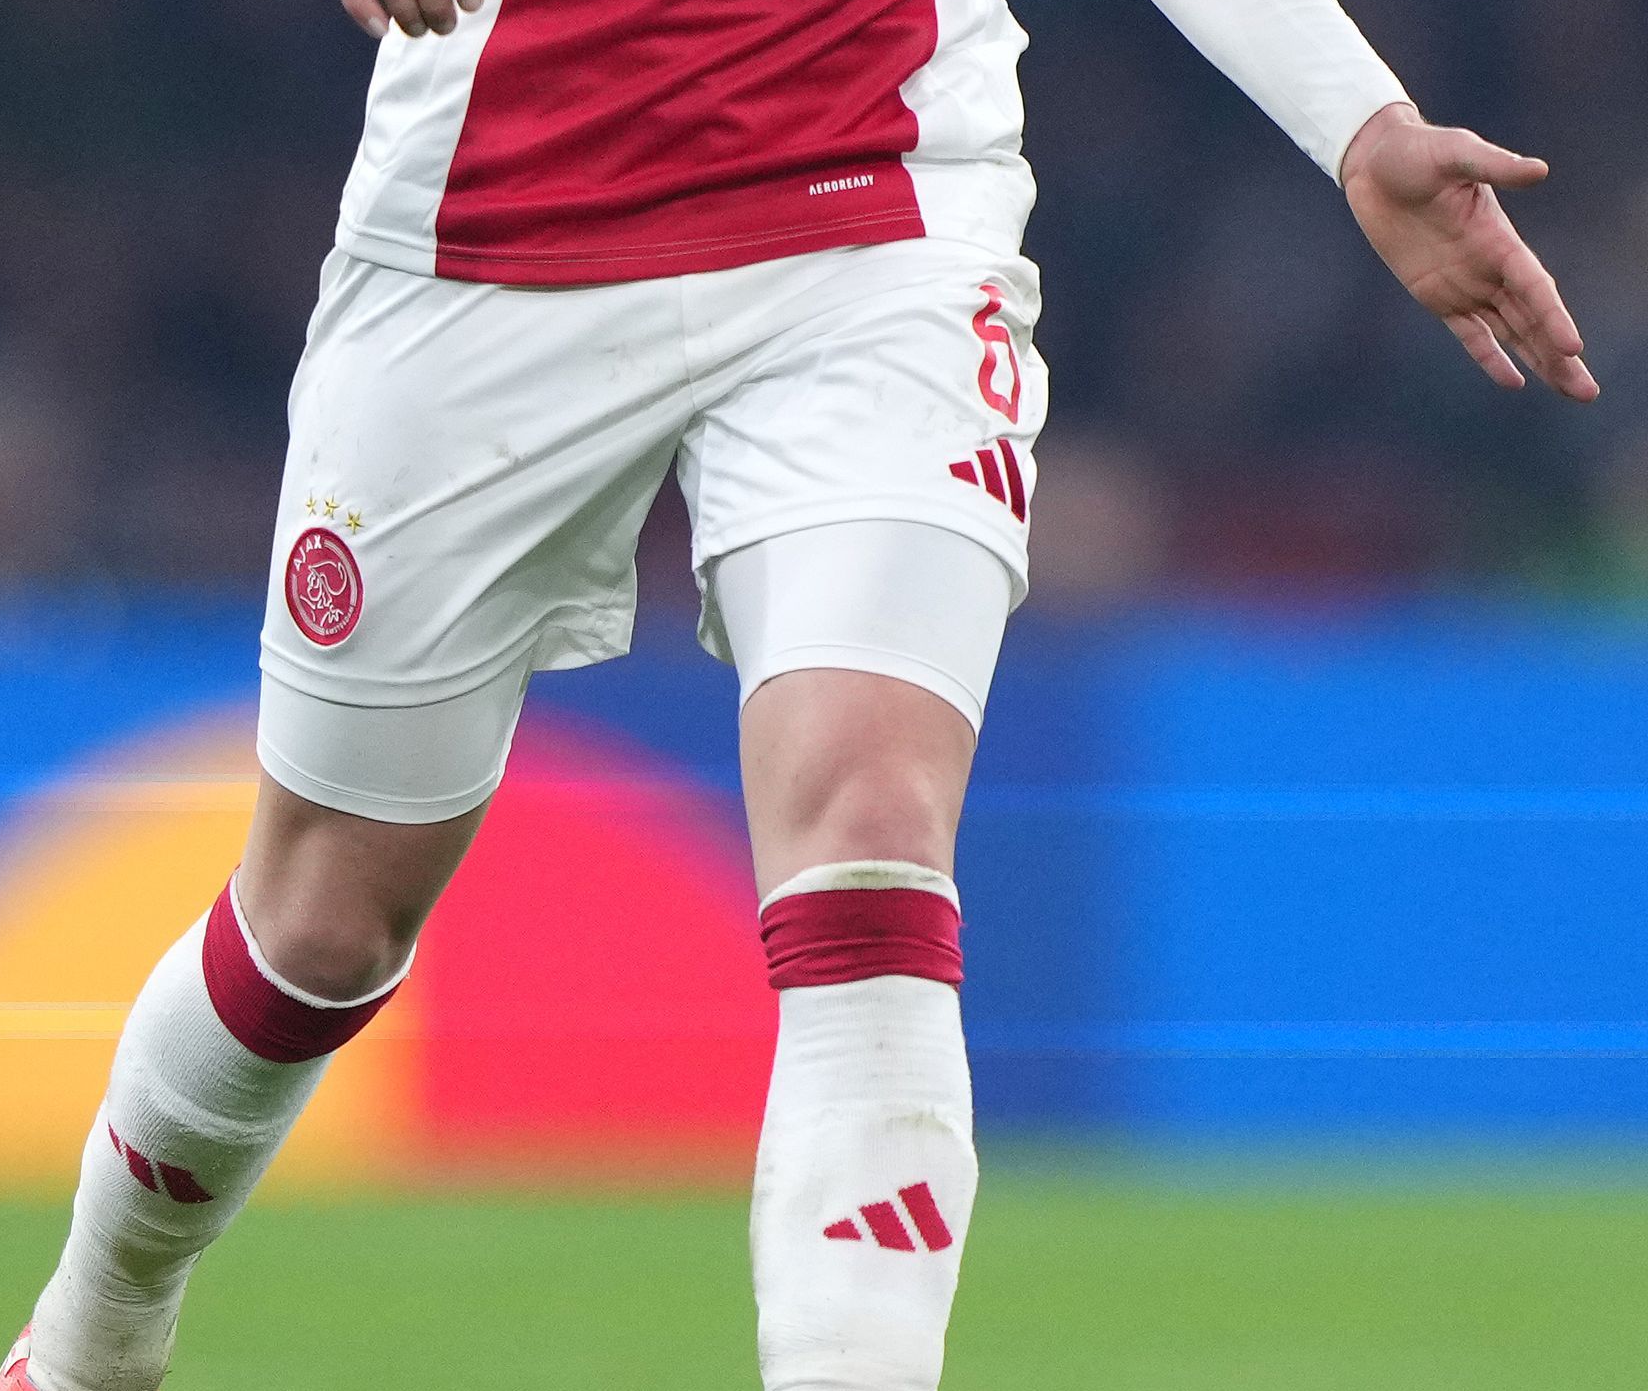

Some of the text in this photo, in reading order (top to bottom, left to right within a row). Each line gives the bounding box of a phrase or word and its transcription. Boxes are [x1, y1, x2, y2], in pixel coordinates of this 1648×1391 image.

[808, 174, 874, 196] AEROREADY
[972, 284, 1021, 425] 6
[294, 534, 322, 571] AJAX
